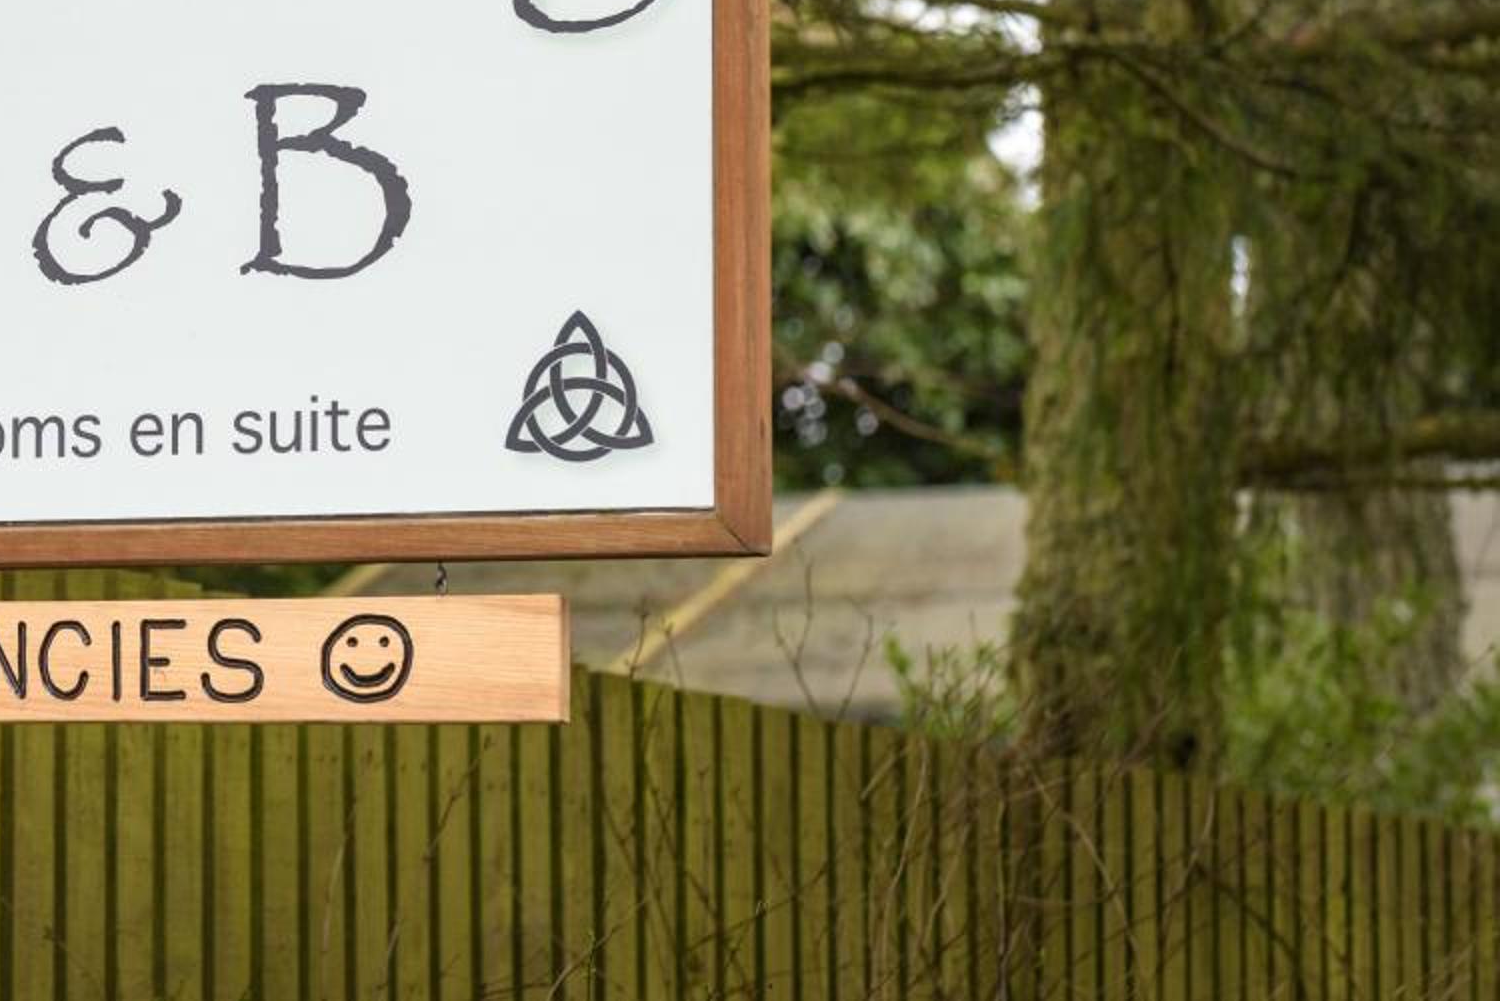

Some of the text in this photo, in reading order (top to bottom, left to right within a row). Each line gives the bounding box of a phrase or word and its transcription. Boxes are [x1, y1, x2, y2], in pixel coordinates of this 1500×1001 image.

[31, 125, 183, 287] &
[240, 82, 413, 281] B
[129, 411, 204, 457] en
[232, 395, 392, 455] suite
